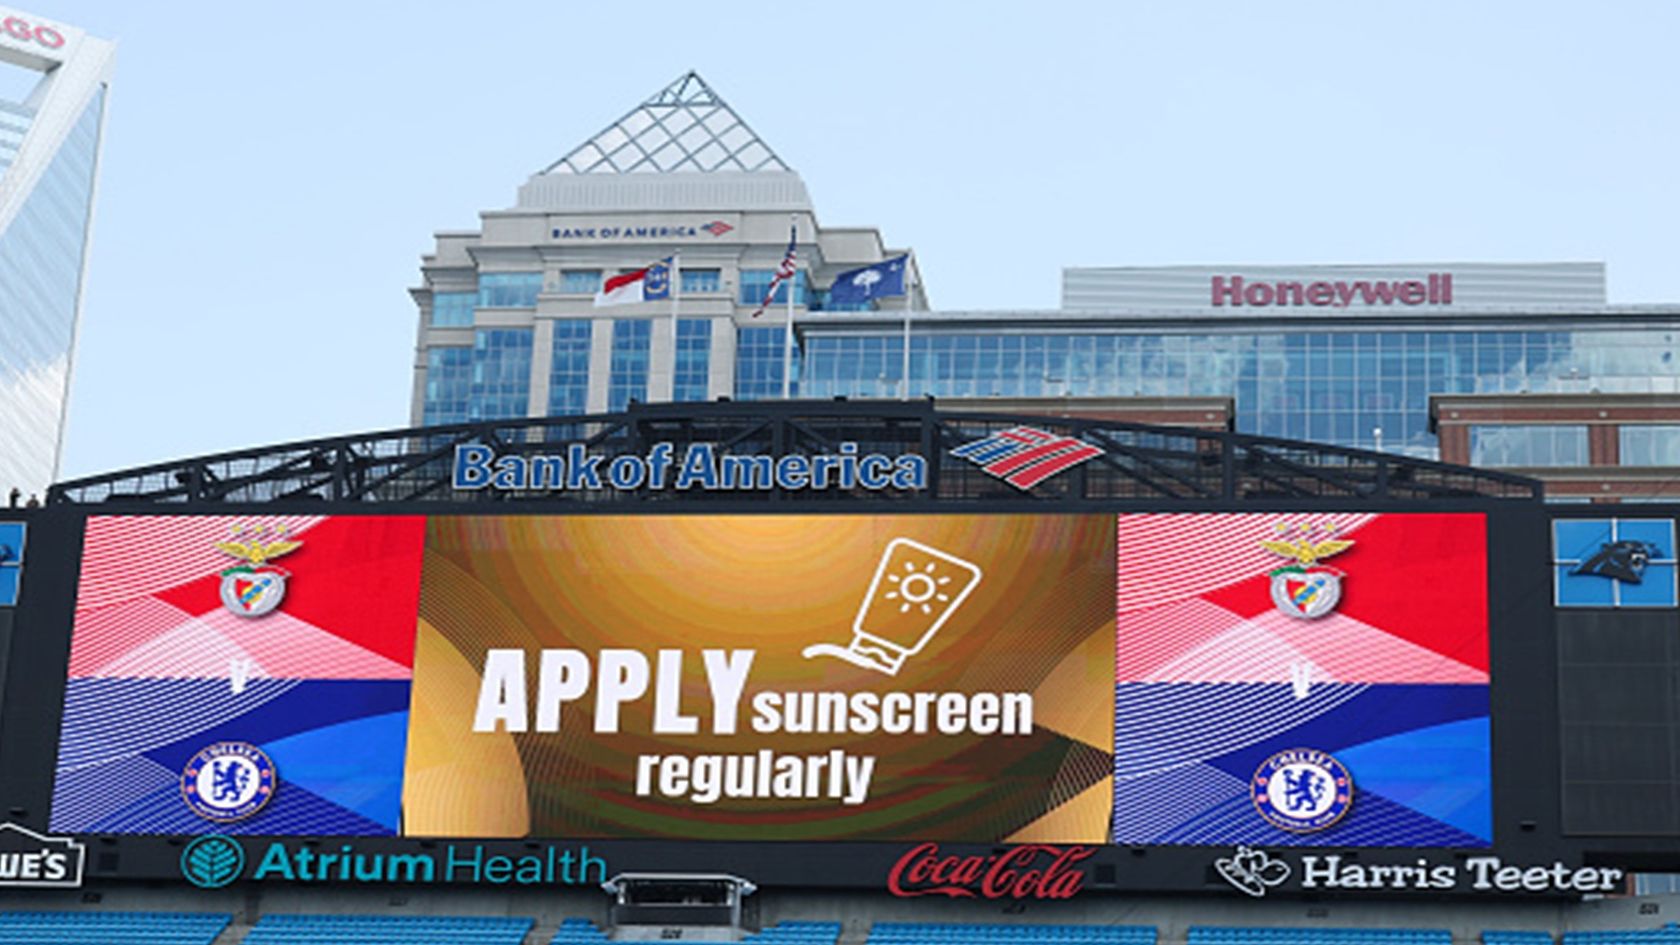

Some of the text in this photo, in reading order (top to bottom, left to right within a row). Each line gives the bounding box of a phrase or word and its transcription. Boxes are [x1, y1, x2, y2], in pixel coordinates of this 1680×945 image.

[0, 15, 65, 49] GO
[552, 226, 697, 239] BANK OF AMERICA
[1211, 273, 1453, 308] Honeywell
[452, 443, 928, 490] Bank of America
[472, 648, 1033, 735] APPLY sunscreen
[636, 749, 876, 804] regularly
[254, 843, 607, 884] Atrium Health
[1300, 855, 1624, 891] Harris Teeter
